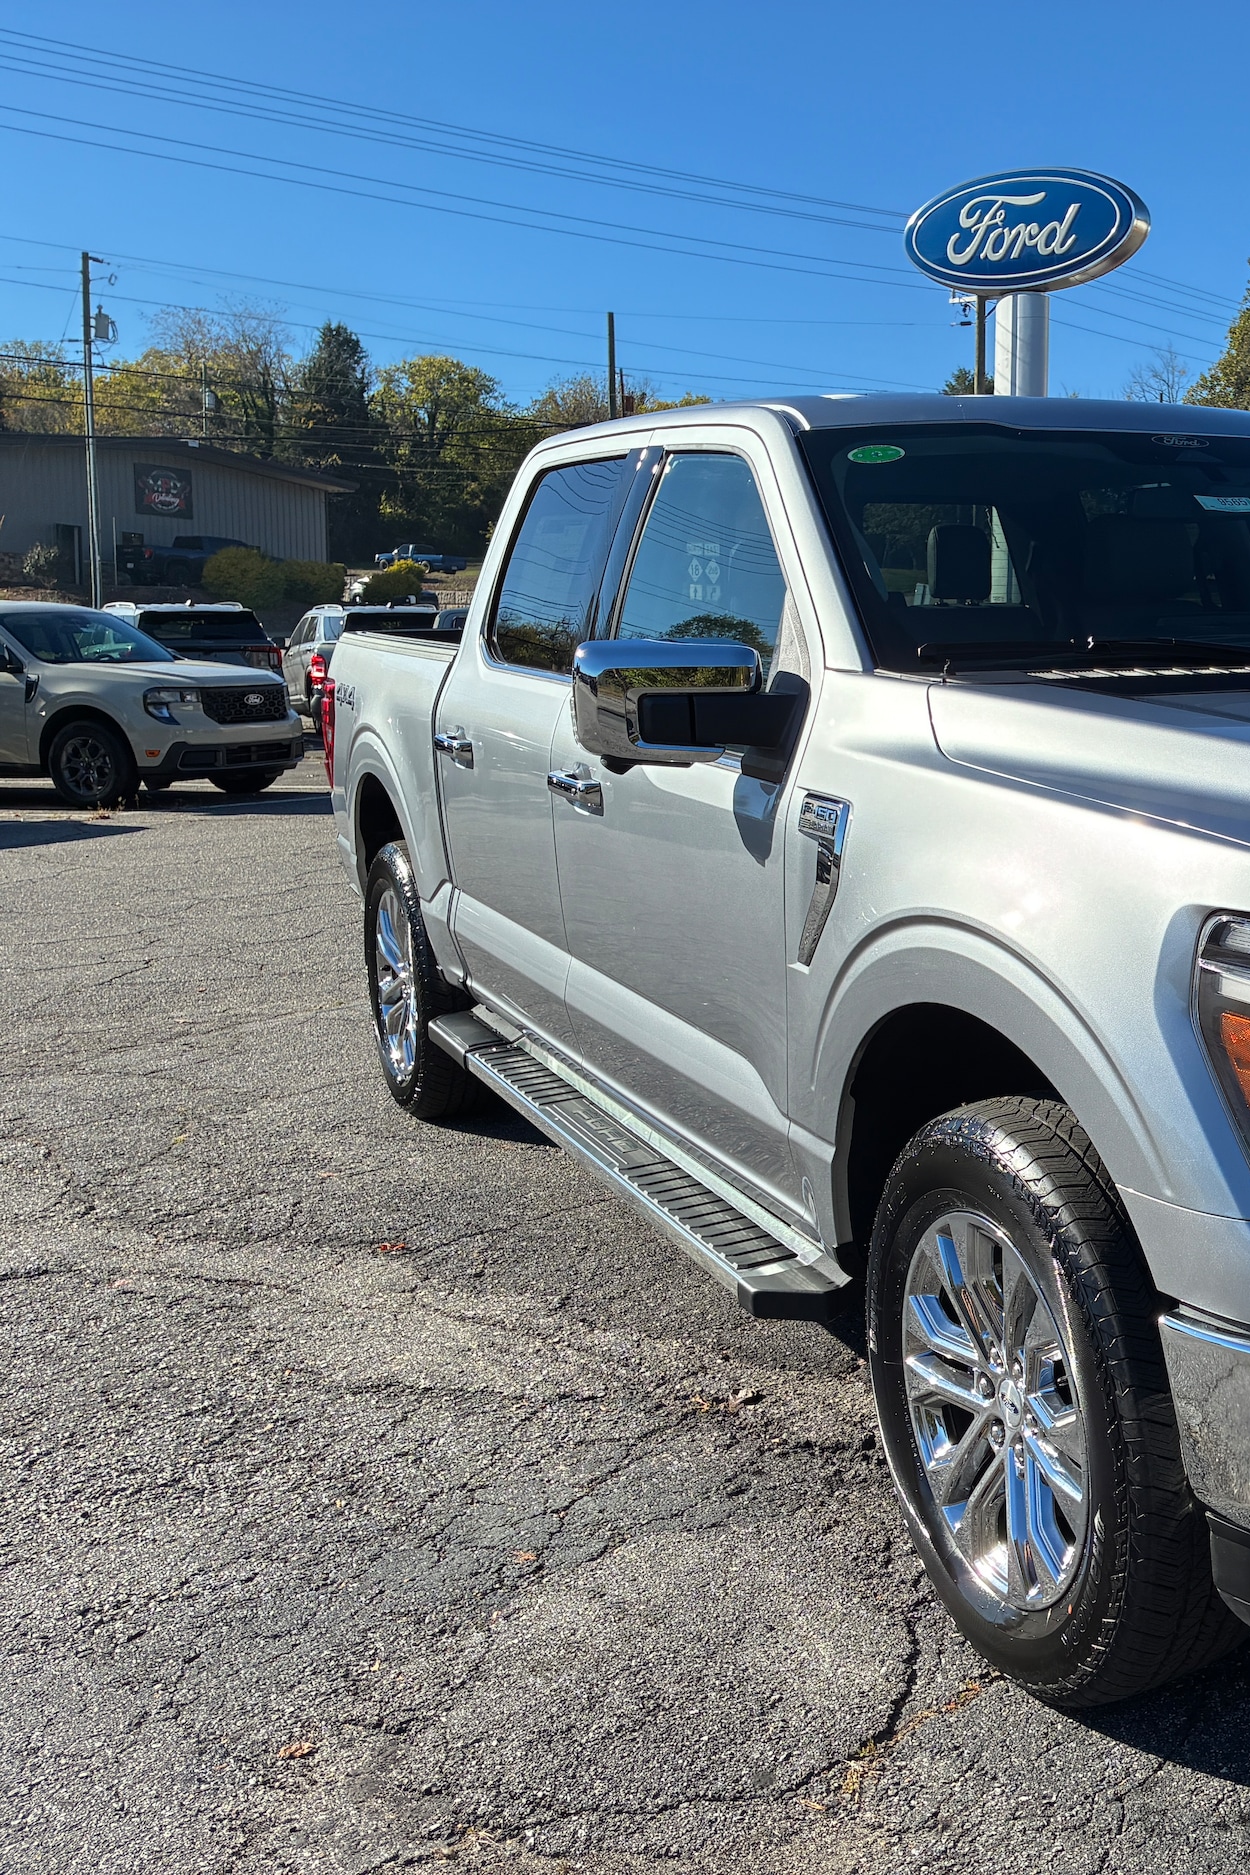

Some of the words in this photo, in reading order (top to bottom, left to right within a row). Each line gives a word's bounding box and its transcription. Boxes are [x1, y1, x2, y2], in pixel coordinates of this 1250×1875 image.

[947, 191, 1082, 266] Ford
[1163, 437, 1201, 446] Ford
[801, 801, 839, 825] F-150
